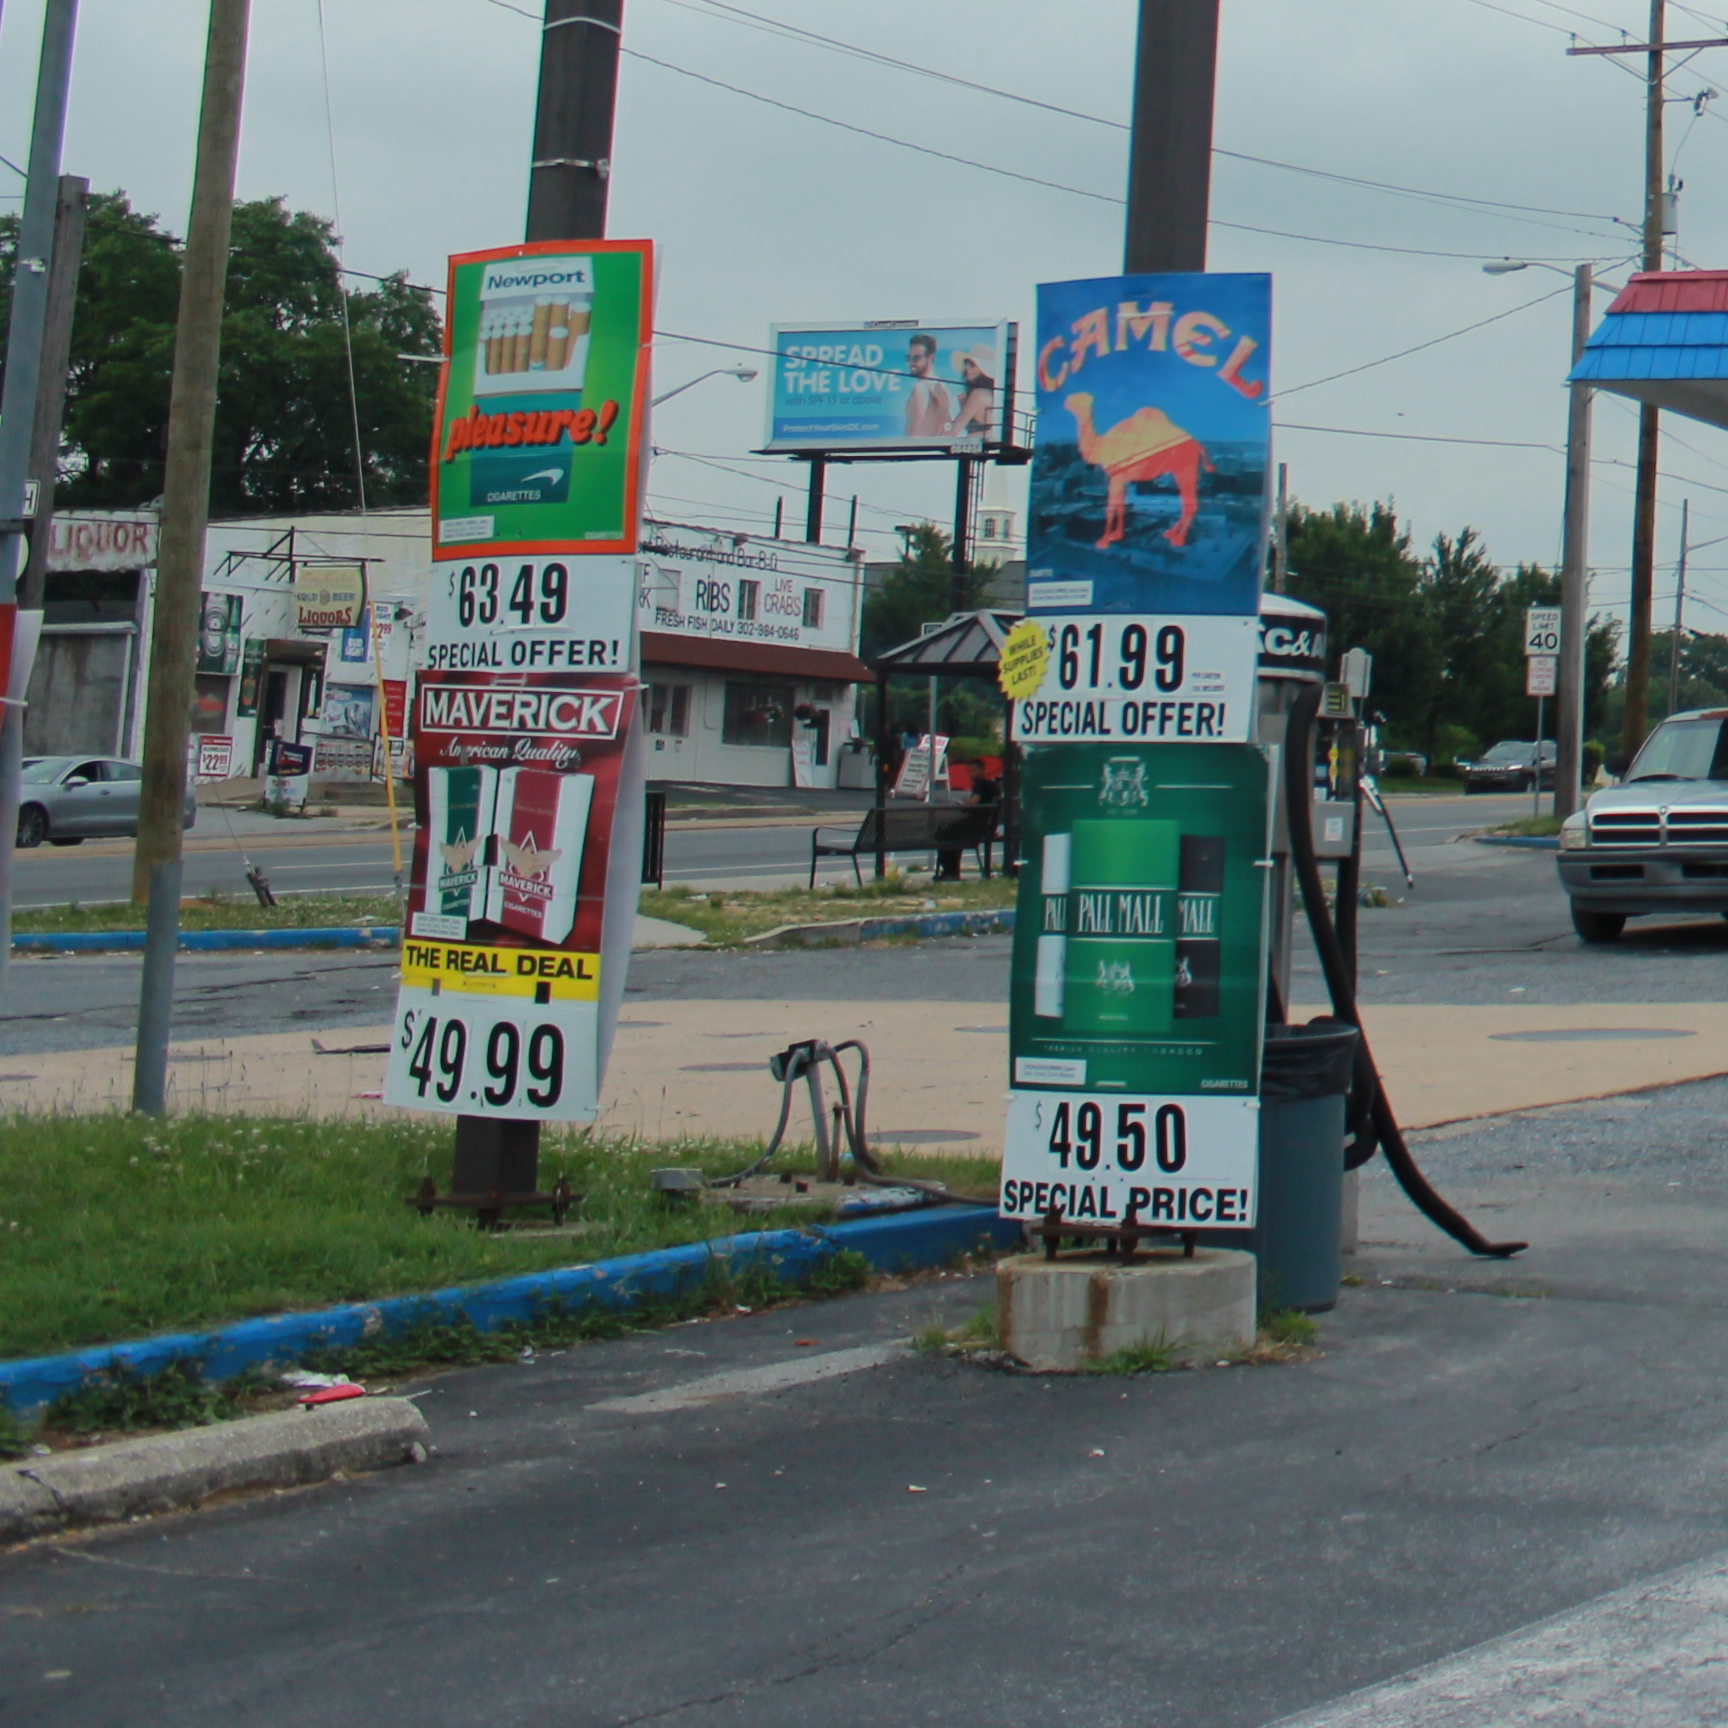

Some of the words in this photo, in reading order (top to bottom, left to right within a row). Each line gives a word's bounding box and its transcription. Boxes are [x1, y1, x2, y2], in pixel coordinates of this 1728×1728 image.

[488, 269, 586, 291] Newport
[785, 344, 885, 370] SPREAD
[1037, 301, 1263, 400] CAMEL
[784, 371, 831, 393] THE
[838, 368, 901, 393] LOVE
[443, 399, 620, 464] pleasure!
[486, 489, 542, 503] CIGARETTES
[50, 522, 150, 561] LIQUOR
[775, 578, 793, 593] LIVE
[299, 605, 353, 625] LIQUORS
[764, 593, 802, 617] CRABS
[1530, 613, 1559, 621] SPEED
[655, 611, 685, 628] FRESH
[687, 616, 708, 630] FISH
[711, 618, 736, 633] DAILY
[1532, 622, 1555, 630] LIMIT
[1008, 634, 1036, 656] WHILE
[1529, 632, 1558, 650] 40
[427, 643, 502, 671] SPECIAL
[510, 639, 620, 667] OFFER!
[1002, 646, 1043, 674] SUPPLIES
[1049, 623, 1185, 693] $61.99
[1011, 665, 1037, 686] LAST!
[423, 690, 612, 733] MAVERICK
[1021, 700, 1112, 735] SPECIAL
[1122, 701, 1226, 737] OFFER!
[500, 873, 552, 899] MAVERICK
[1077, 893, 1113, 933] PALL
[1117, 893, 1164, 934] MALL
[405, 946, 441, 969] THE
[446, 949, 506, 974] REAL
[516, 955, 594, 981] DEAL
[1004, 1178, 1117, 1220] SPECIAL
[1129, 1185, 1248, 1222] PRICE!
